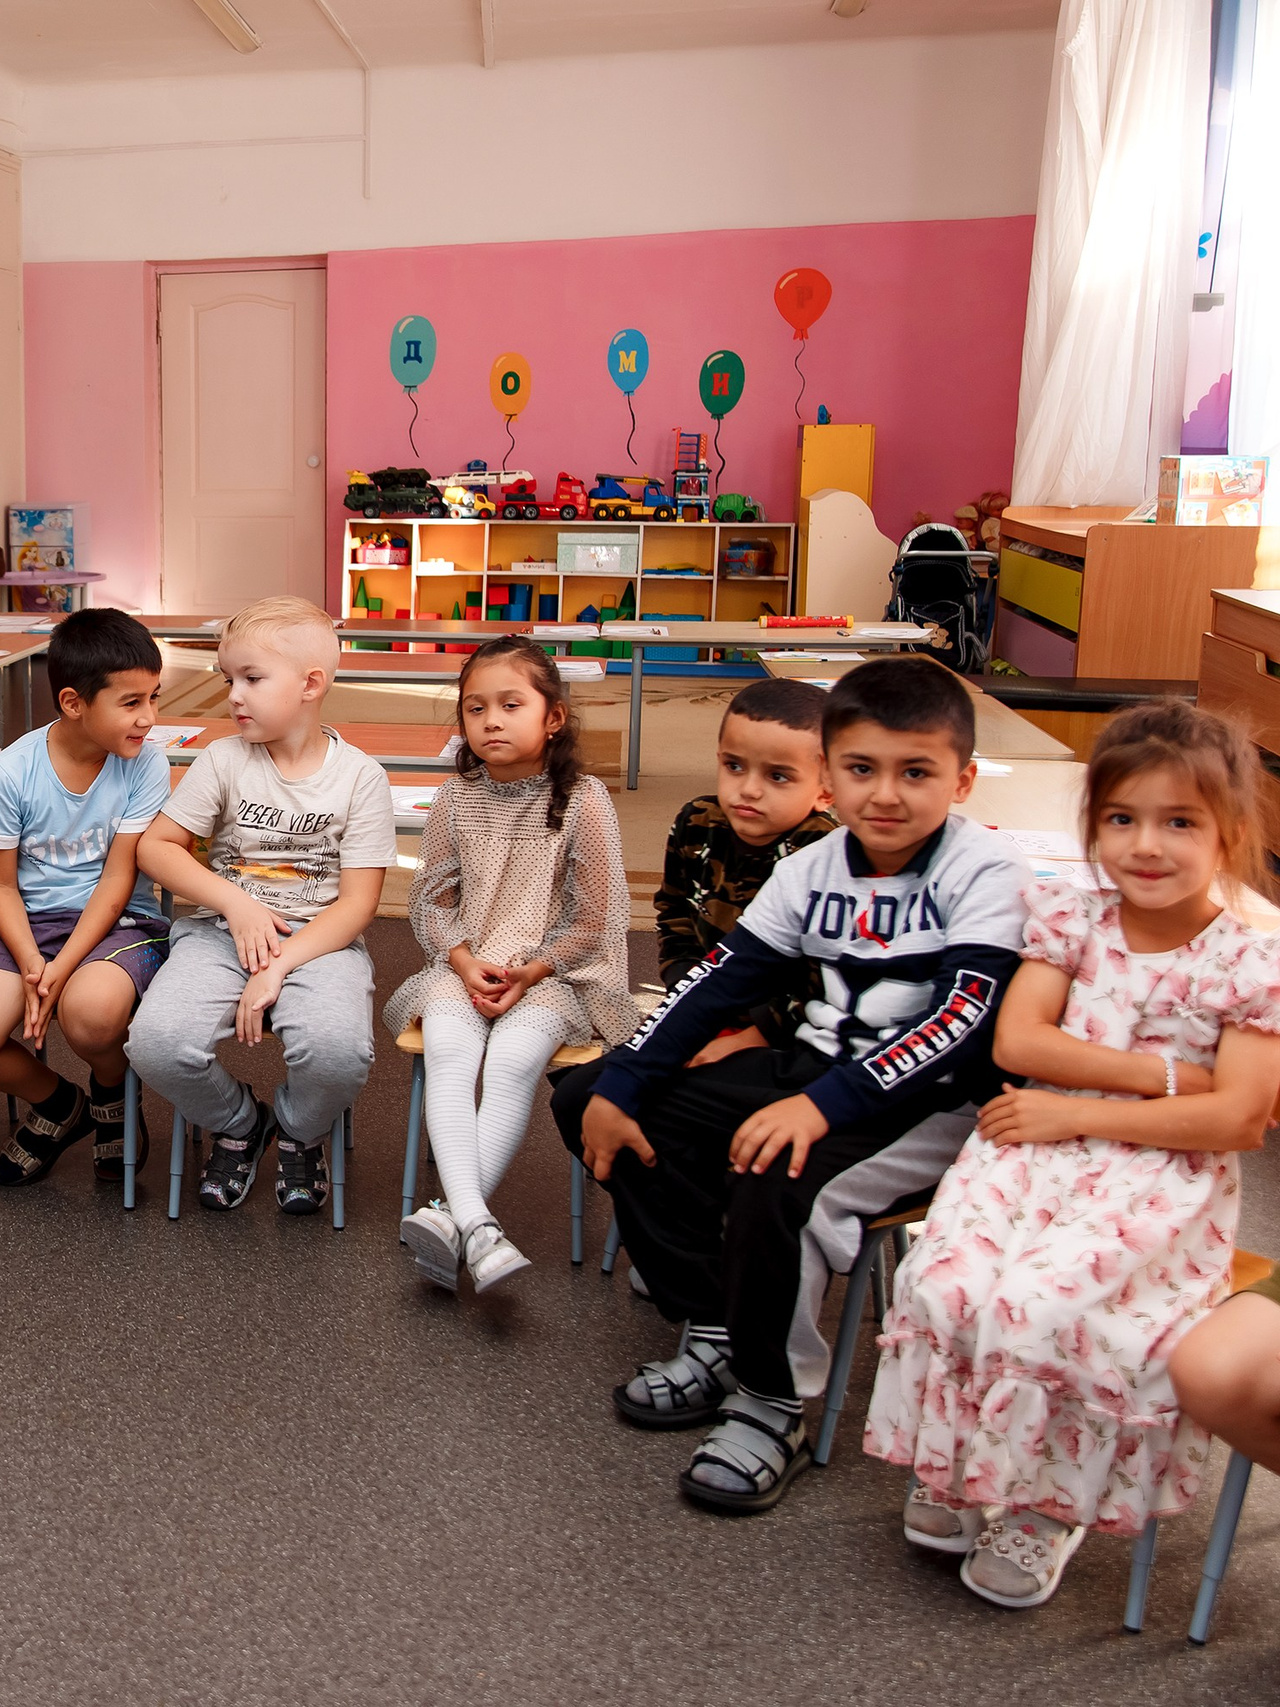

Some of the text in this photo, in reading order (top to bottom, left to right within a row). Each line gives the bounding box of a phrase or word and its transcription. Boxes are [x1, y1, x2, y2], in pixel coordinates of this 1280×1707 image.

[403, 340, 423, 364] Д
[501, 371, 520, 395] О
[618, 350, 637, 373] М
[711, 373, 730, 396] И
[238, 799, 334, 832] DESERT VIBES
[876, 995, 980, 1083] JORDAN
